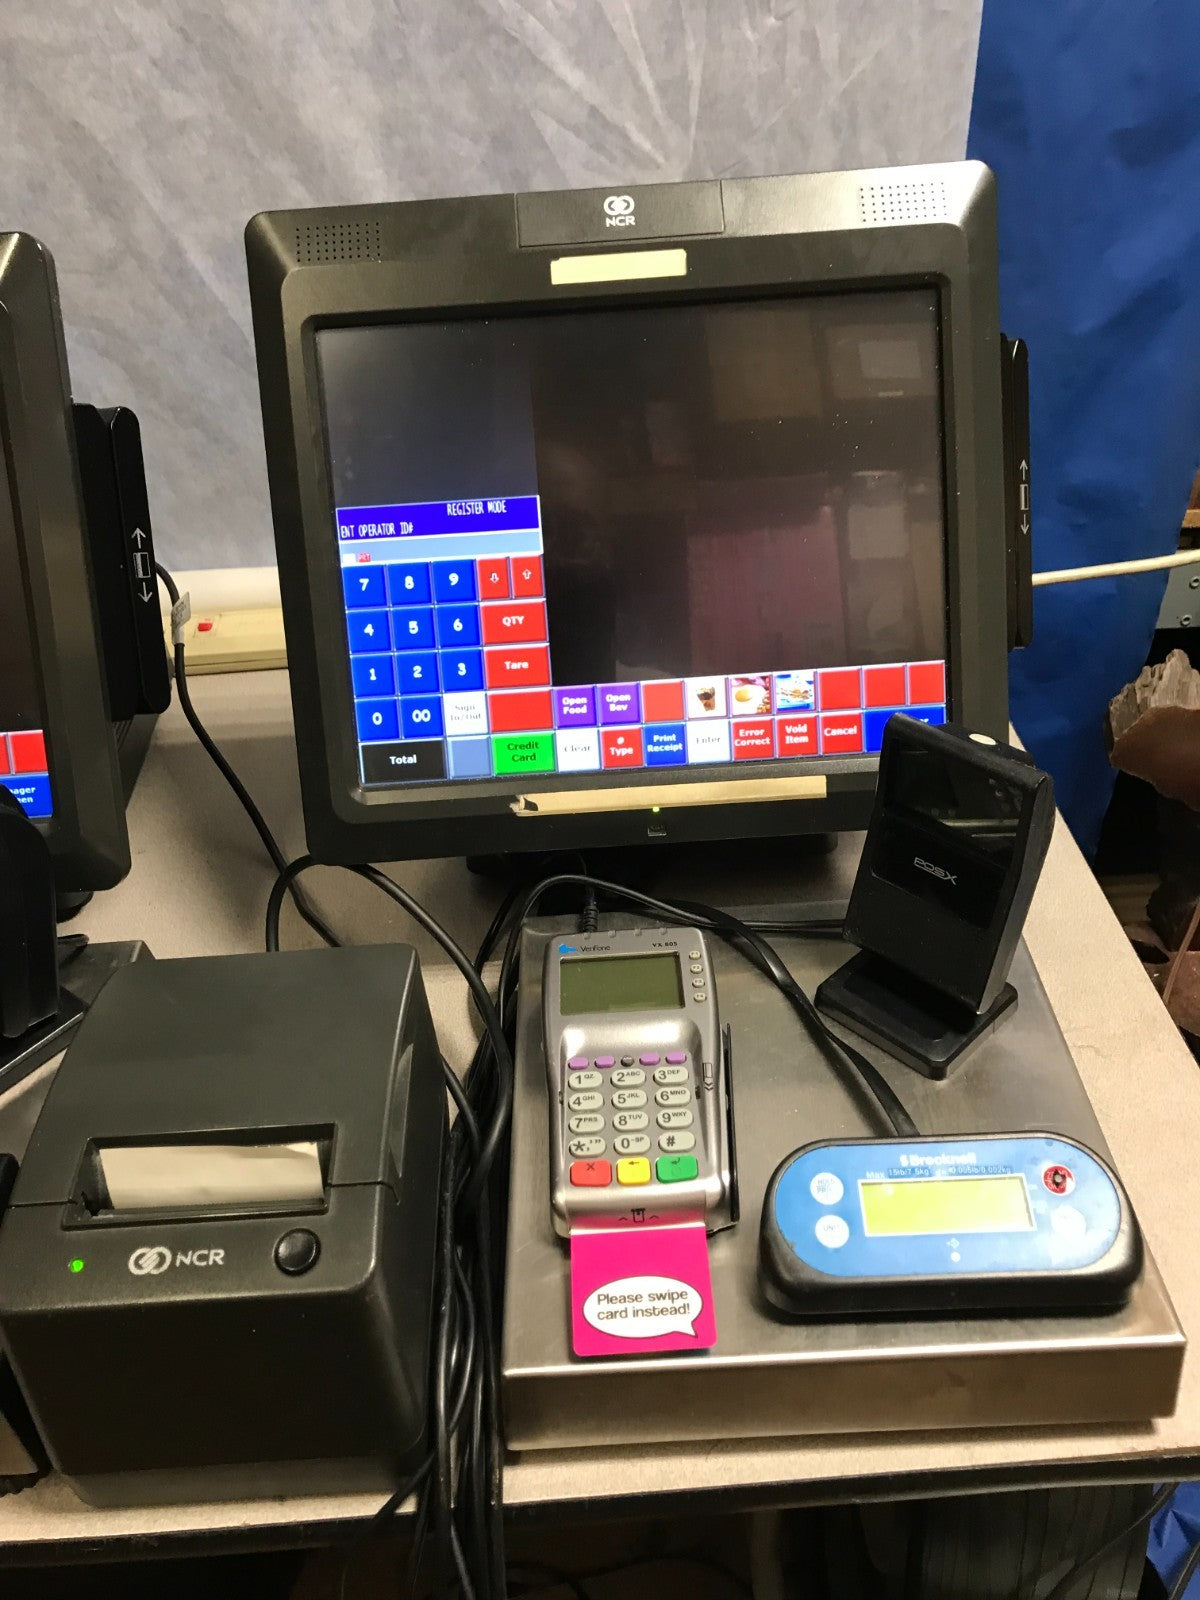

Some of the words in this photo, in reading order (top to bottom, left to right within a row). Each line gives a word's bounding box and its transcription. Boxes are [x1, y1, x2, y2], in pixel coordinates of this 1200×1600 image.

[605, 216, 636, 227] NCR
[446, 502, 485, 516] REGISTER
[487, 500, 507, 514] MODE
[340, 525, 355, 539] ENT
[358, 523, 396, 537] OPERATOR
[399, 522, 413, 535] ID#
[358, 578, 370, 592] 7
[404, 575, 415, 590] 8
[448, 572, 460, 586] 9
[452, 618, 464, 632] 6
[502, 615, 525, 627] QTY
[363, 623, 375, 637] 4
[408, 620, 419, 635] 5
[457, 662, 467, 677] 3
[504, 660, 529, 670] Tare
[369, 668, 377, 681] 1
[412, 665, 423, 679] 2
[562, 696, 588, 706] Open
[605, 693, 632, 703] Open
[563, 706, 588, 715] Food
[609, 703, 629, 712] Bev
[372, 712, 384, 726] 0
[412, 709, 431, 722] 00
[739, 729, 765, 738] Error
[785, 724, 808, 735] Void
[824, 725, 858, 737] Cancel
[653, 733, 677, 743] Print
[734, 737, 770, 747] Correct
[785, 735, 809, 745] Item
[507, 742, 540, 752] Credit
[609, 747, 634, 756] Type
[647, 743, 683, 753] Receipt
[389, 754, 418, 765] Total
[511, 753, 537, 763] Card
[10, 787, 36, 796] ager
[666, 1135, 676, 1147] #
[175, 1249, 225, 1267] NCR
[597, 1293, 643, 1305] Please
[648, 1290, 688, 1304] swipe
[597, 1308, 628, 1320] card
[632, 1303, 690, 1318] instead!
